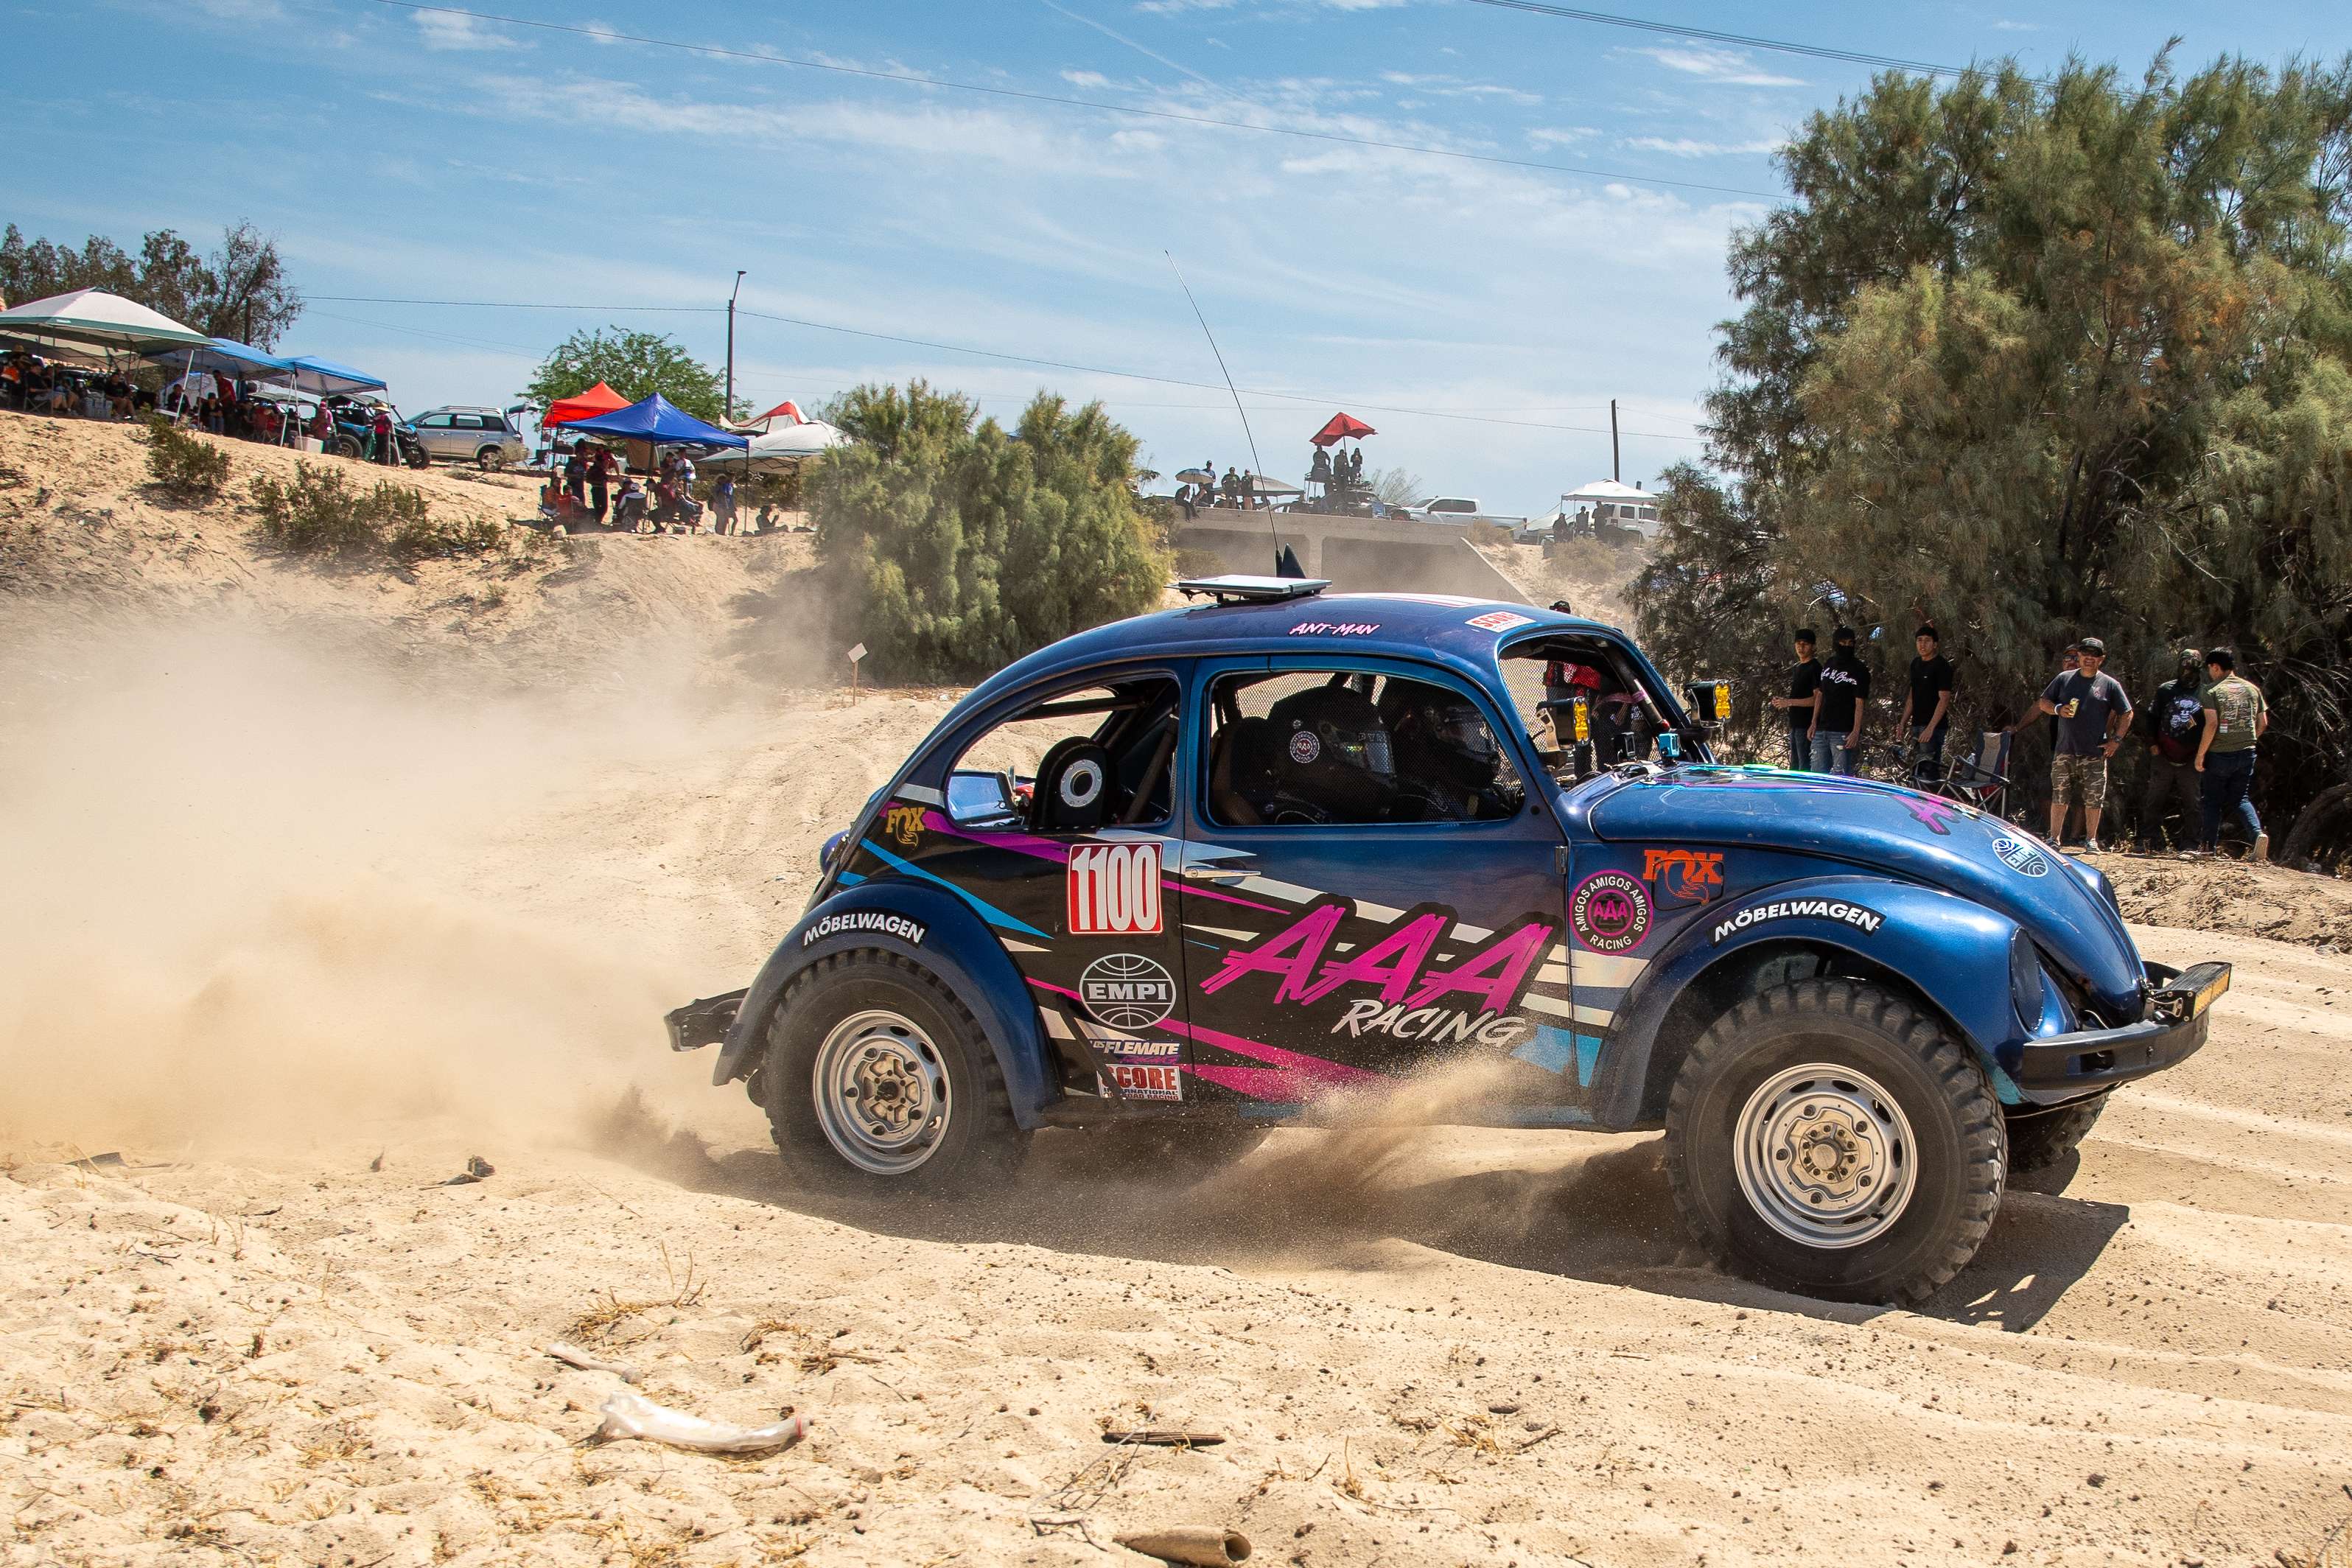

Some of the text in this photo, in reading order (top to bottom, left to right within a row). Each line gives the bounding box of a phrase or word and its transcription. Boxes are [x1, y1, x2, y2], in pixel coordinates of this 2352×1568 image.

[1289, 623, 1381, 636] ANT-MAN
[886, 807, 925, 848] FOX
[1072, 845, 1158, 931] 1100
[1642, 850, 1723, 903] FOX
[1575, 876, 1647, 932] AMIGOS AMIGOS AMIGOS
[1593, 900, 1628, 920] AAA
[1715, 901, 1880, 942] MÖBELWAGEN
[804, 913, 925, 946] MÖBELWAGEN
[1589, 934, 1631, 950] RACING
[1200, 904, 1553, 1015] AAA
[1087, 983, 1167, 1000] EMPI
[1331, 999, 1527, 1048] RACING
[1104, 1040, 1180, 1055] FLEMATE
